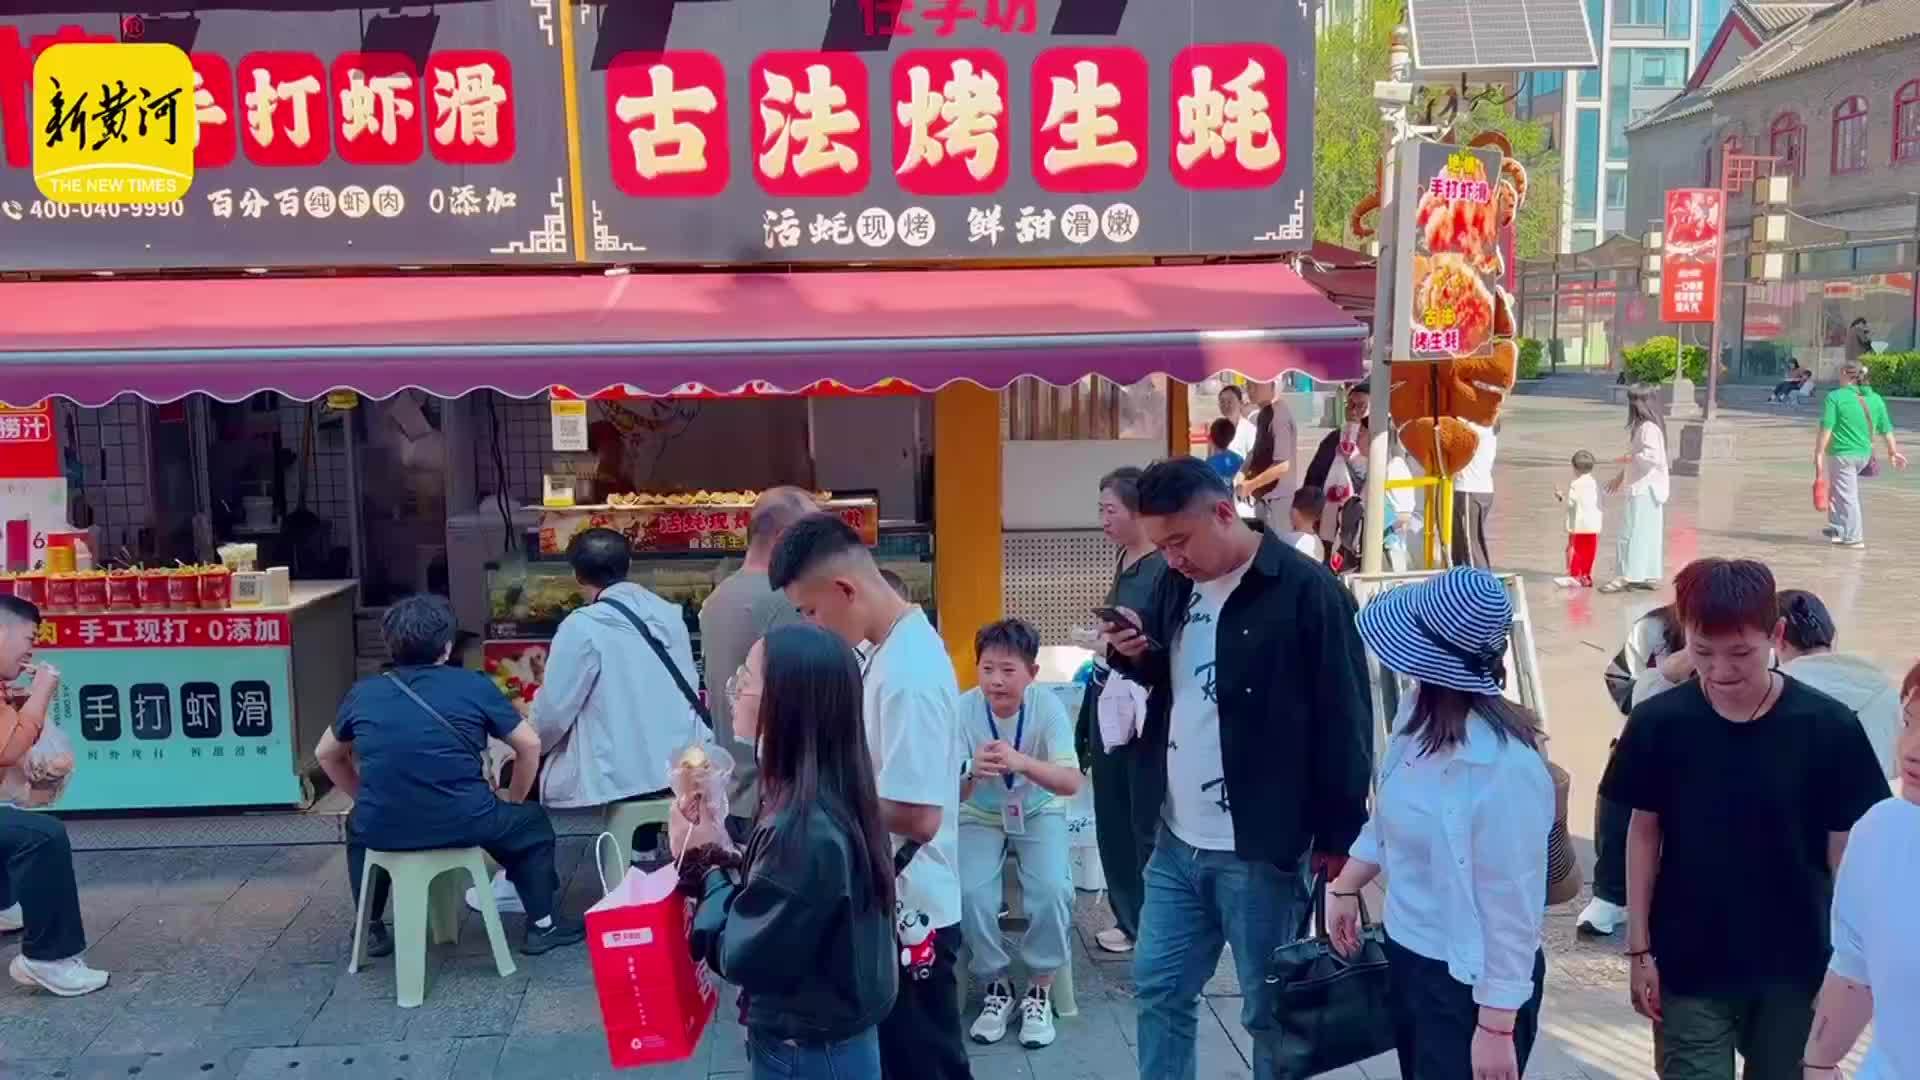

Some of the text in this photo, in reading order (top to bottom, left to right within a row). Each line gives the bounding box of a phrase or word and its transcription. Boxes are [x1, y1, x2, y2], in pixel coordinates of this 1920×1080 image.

[614, 57, 1282, 181] 古法烤生蚝
[30, 199, 184, 219] 400-040-9990
[206, 184, 518, 218] 百分百纯虾肉 0添加
[763, 203, 1140, 249] 活蚝现烤 鲜甜滑嫩
[84, 690, 268, 732] 手打虾滑
